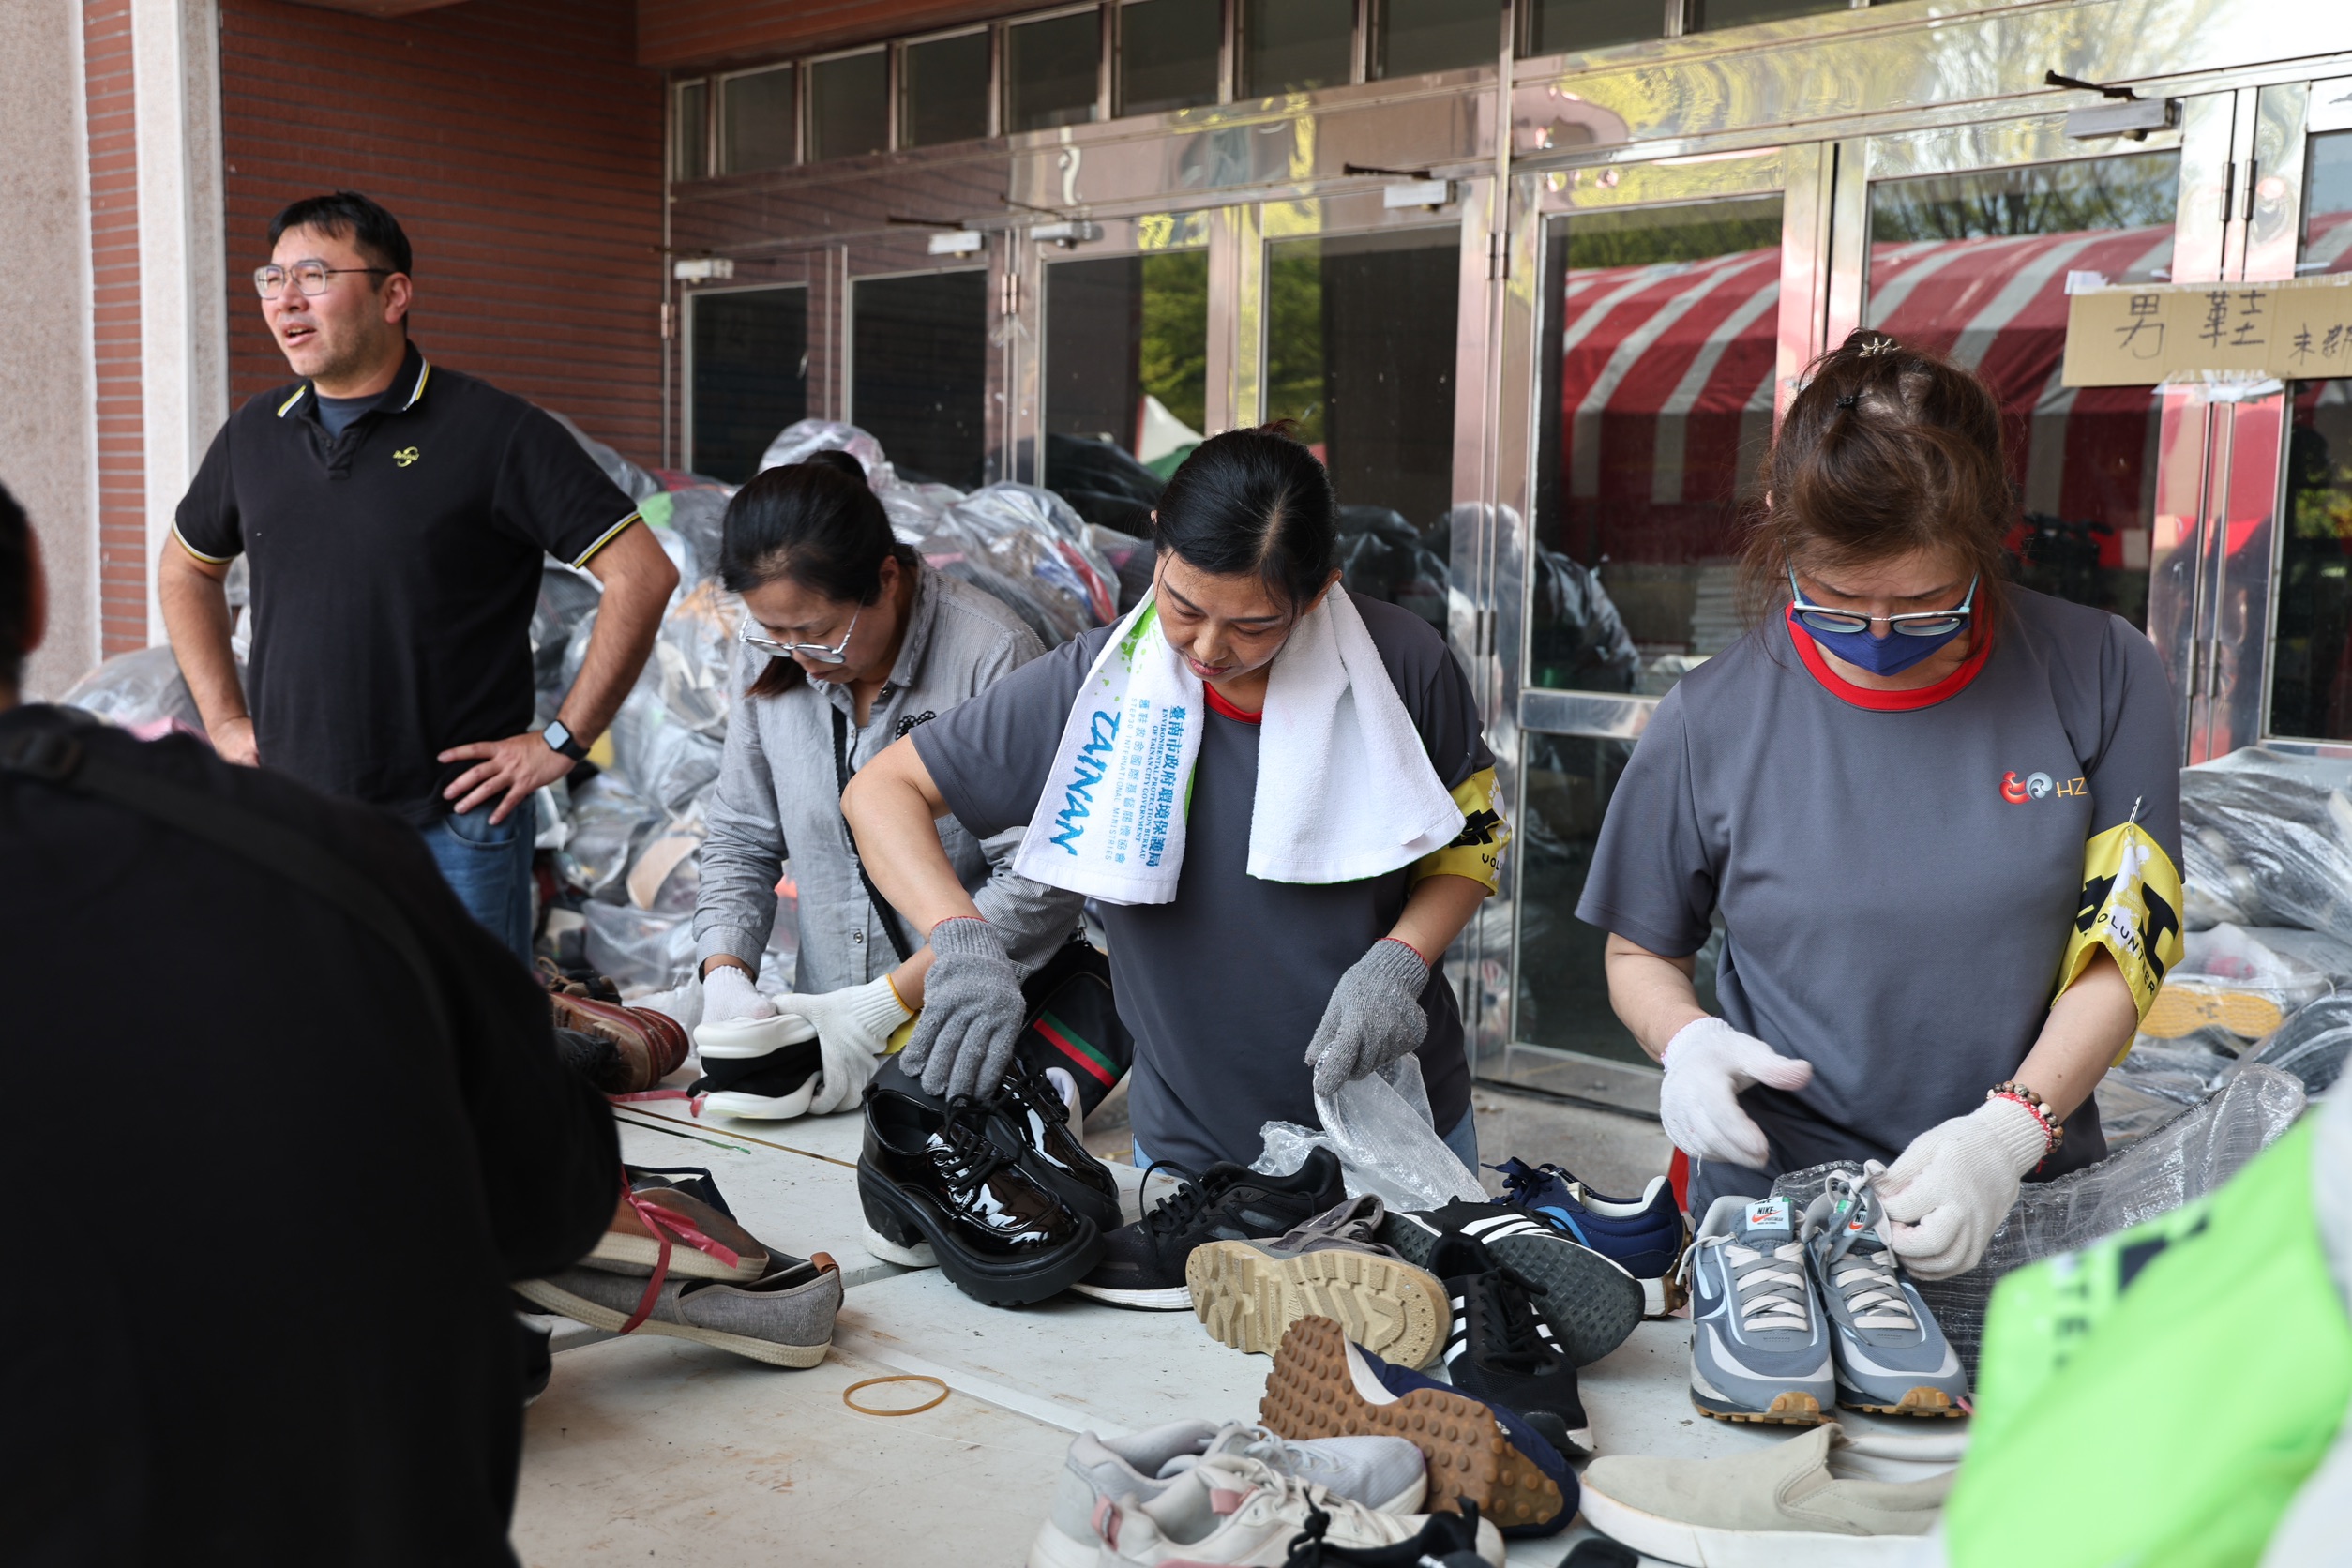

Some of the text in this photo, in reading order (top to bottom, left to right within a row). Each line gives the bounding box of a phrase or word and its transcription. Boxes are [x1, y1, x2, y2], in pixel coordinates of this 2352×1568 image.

[2115, 290, 2266, 360] 男鞋
[1048, 710, 1121, 857] TAINAN
[1105, 698, 1138, 861] STEP30 INTERNATIONAL MINISTRIES
[1136, 725, 1159, 842] OF TAINAN CITY GOVERNMENT
[1138, 708, 1168, 860] ENVIRONMENTAL PROTECTION BUREAU
[1146, 705, 1186, 867] 臺南市政府環境保護局
[2056, 777, 2088, 798] HZ
[2095, 912, 2156, 995] OLUNTEER
[1756, 1206, 1774, 1215] NIKE
